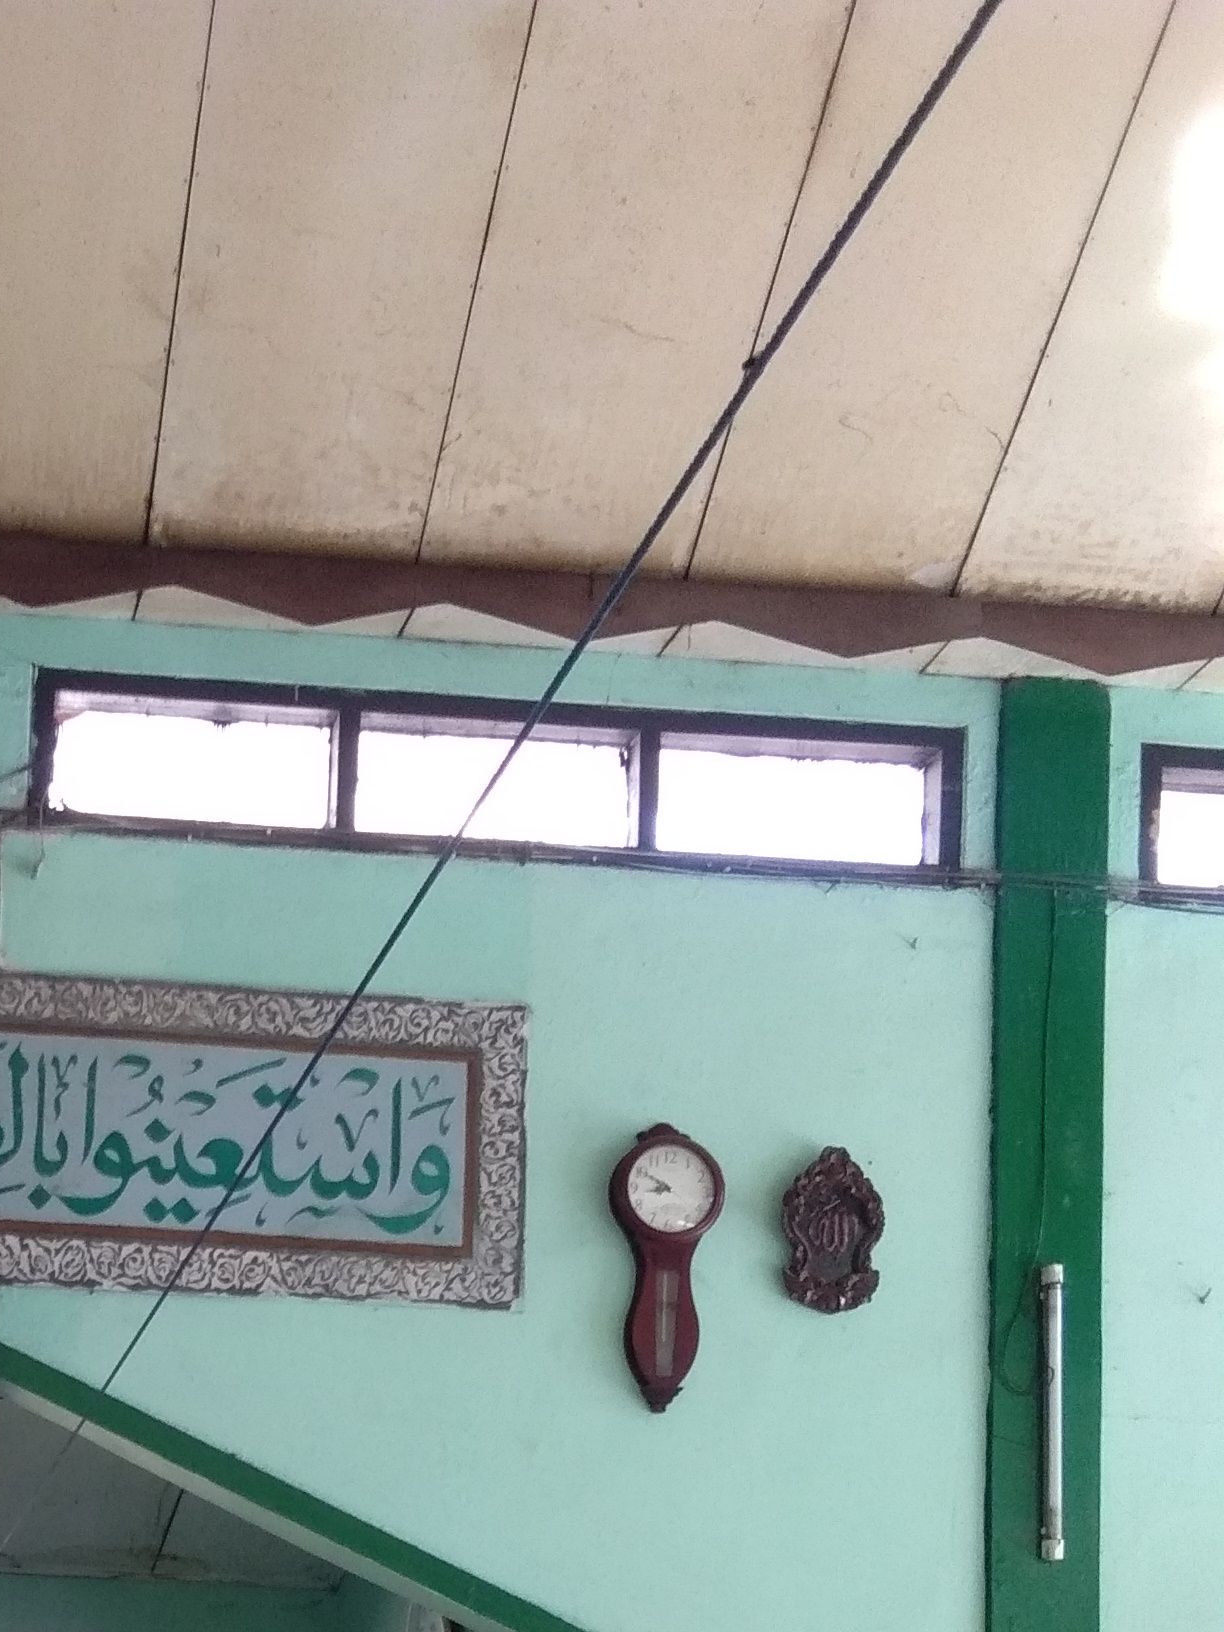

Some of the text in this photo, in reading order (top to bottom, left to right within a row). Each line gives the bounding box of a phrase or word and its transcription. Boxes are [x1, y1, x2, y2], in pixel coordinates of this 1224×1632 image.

[649, 1154, 659, 1167] 11
[664, 1151, 677, 1164] 12
[697, 1170, 705, 1183] 2
